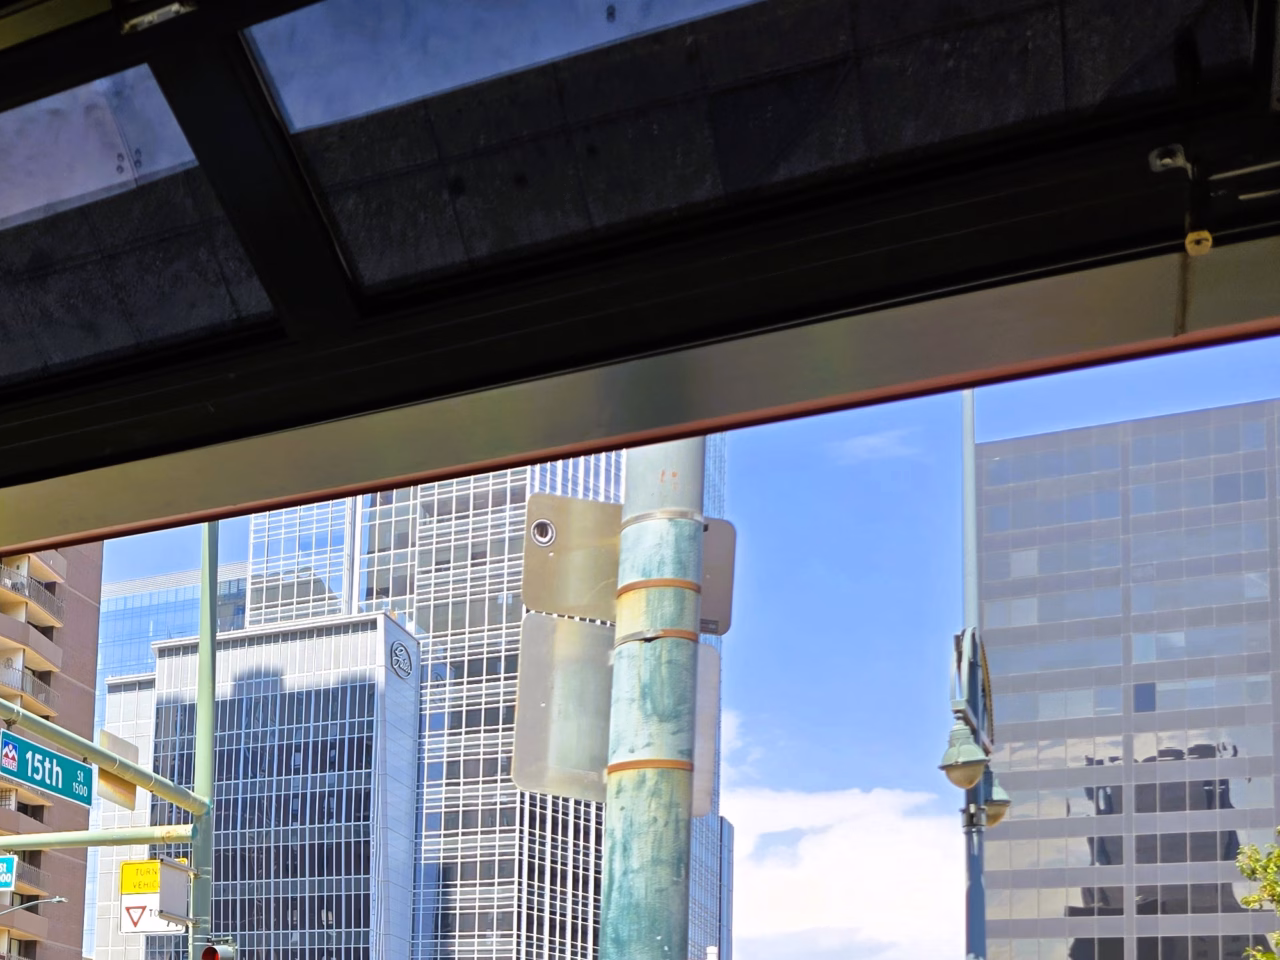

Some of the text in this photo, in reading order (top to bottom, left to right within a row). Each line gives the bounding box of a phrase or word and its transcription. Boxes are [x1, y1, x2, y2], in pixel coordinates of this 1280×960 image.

[26, 750, 62, 788] 15th
[77, 770, 84, 782] St
[72, 781, 88, 797] 1500
[149, 909, 160, 918] TO
